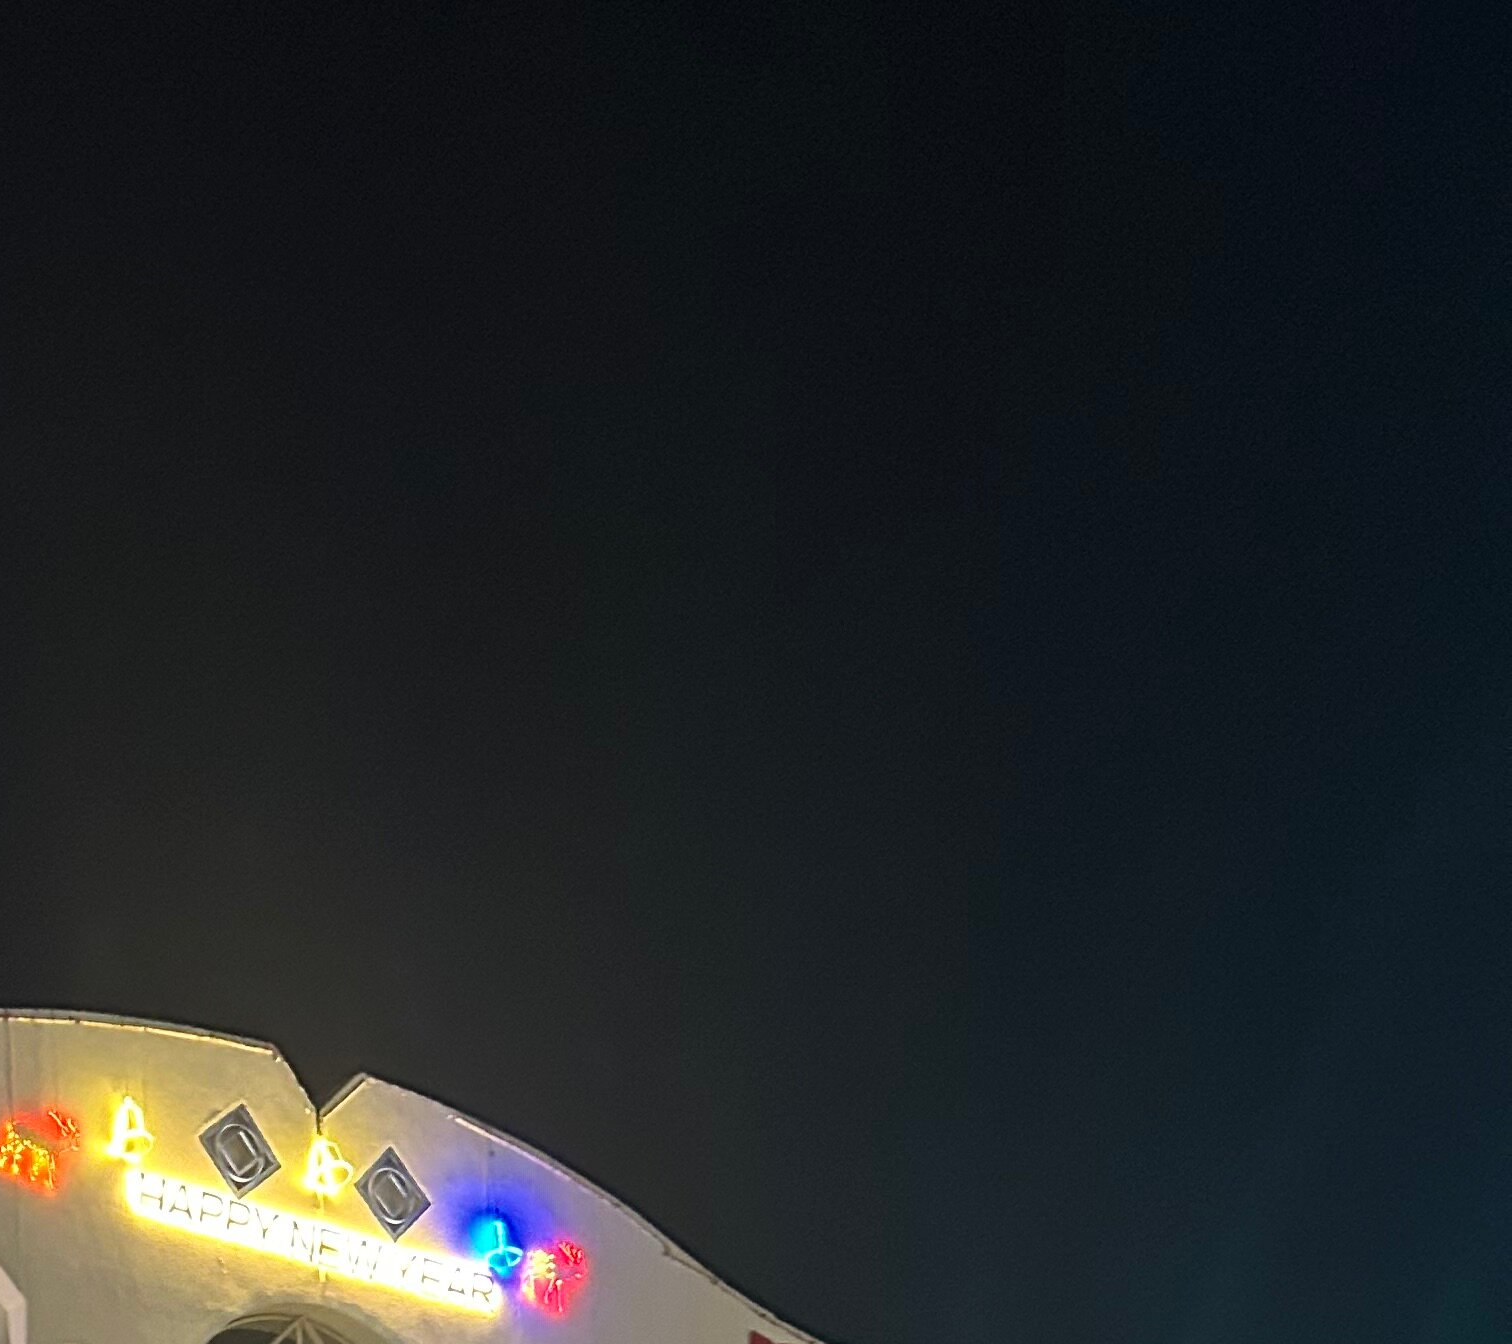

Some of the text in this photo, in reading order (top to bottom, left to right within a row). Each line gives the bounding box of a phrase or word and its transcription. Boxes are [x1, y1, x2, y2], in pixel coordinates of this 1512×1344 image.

[138, 1172, 496, 1303] HAPPY NEW YEAR
